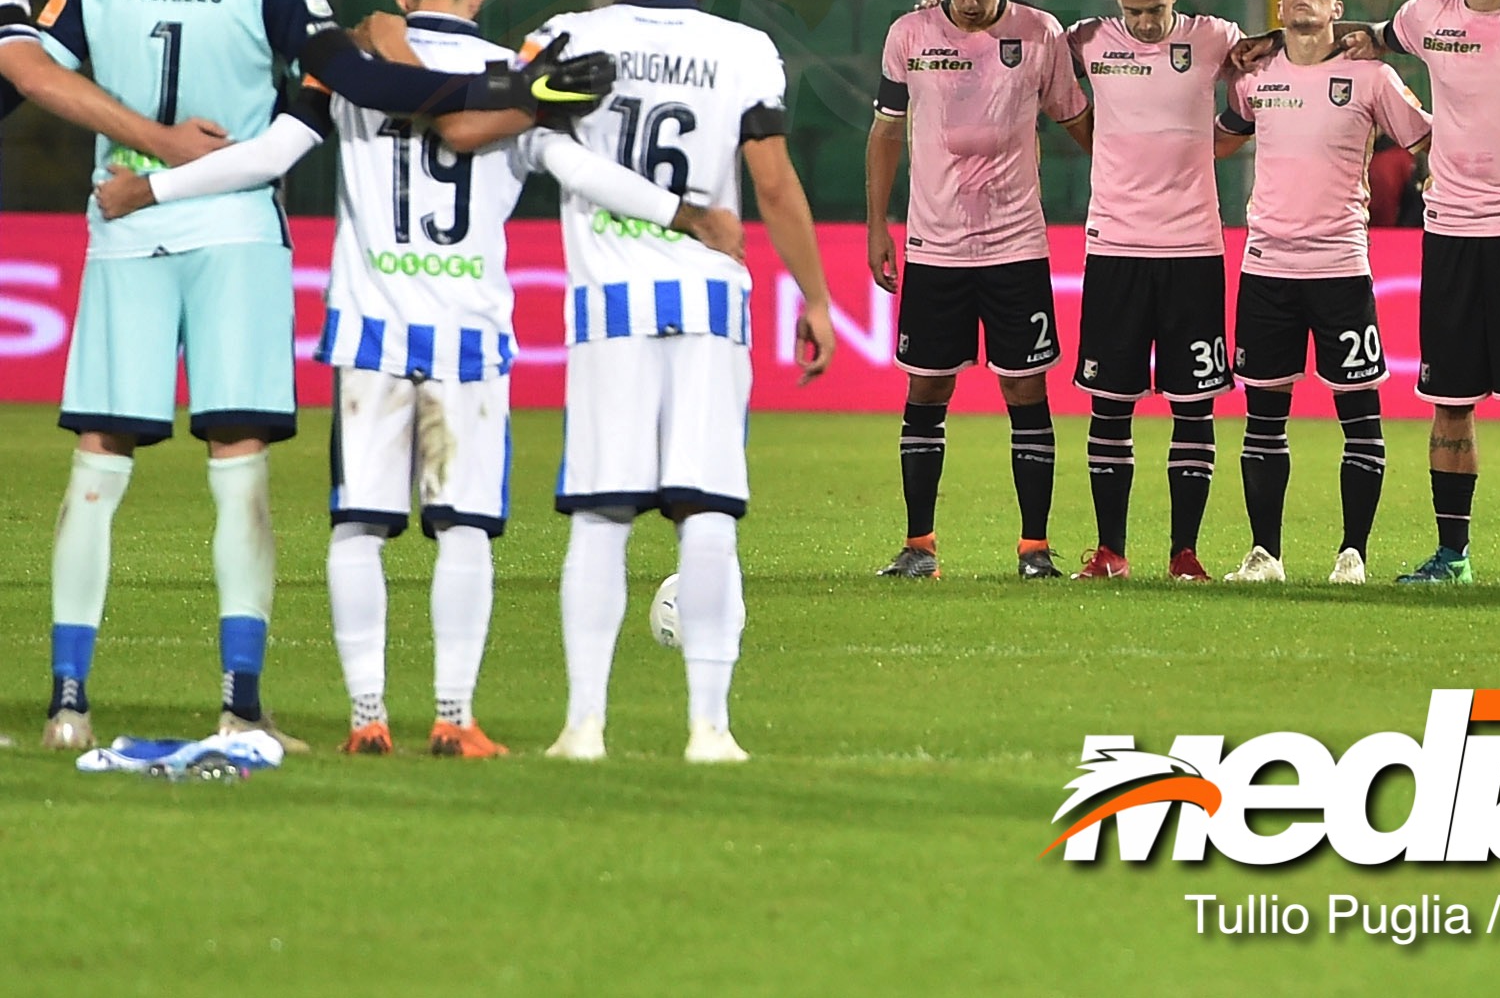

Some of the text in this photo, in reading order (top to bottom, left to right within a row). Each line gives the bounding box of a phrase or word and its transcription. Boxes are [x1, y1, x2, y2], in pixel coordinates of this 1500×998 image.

[1423, 37, 1481, 53] Bisaten
[1435, 28, 1467, 38] LEGEA
[907, 58, 973, 72] Bisaten
[921, 48, 959, 57] LEGEA
[1102, 51, 1135, 60] LEGEA
[149, 21, 183, 126] 1
[612, 50, 718, 89] RUGMAN
[1090, 62, 1152, 76] Bisaten
[1257, 83, 1290, 93] LEGEA
[608, 94, 697, 197] 16
[376, 116, 474, 245] 19
[1029, 311, 1052, 350] 2
[1190, 336, 1226, 379] 30
[1338, 324, 1382, 368] 20
